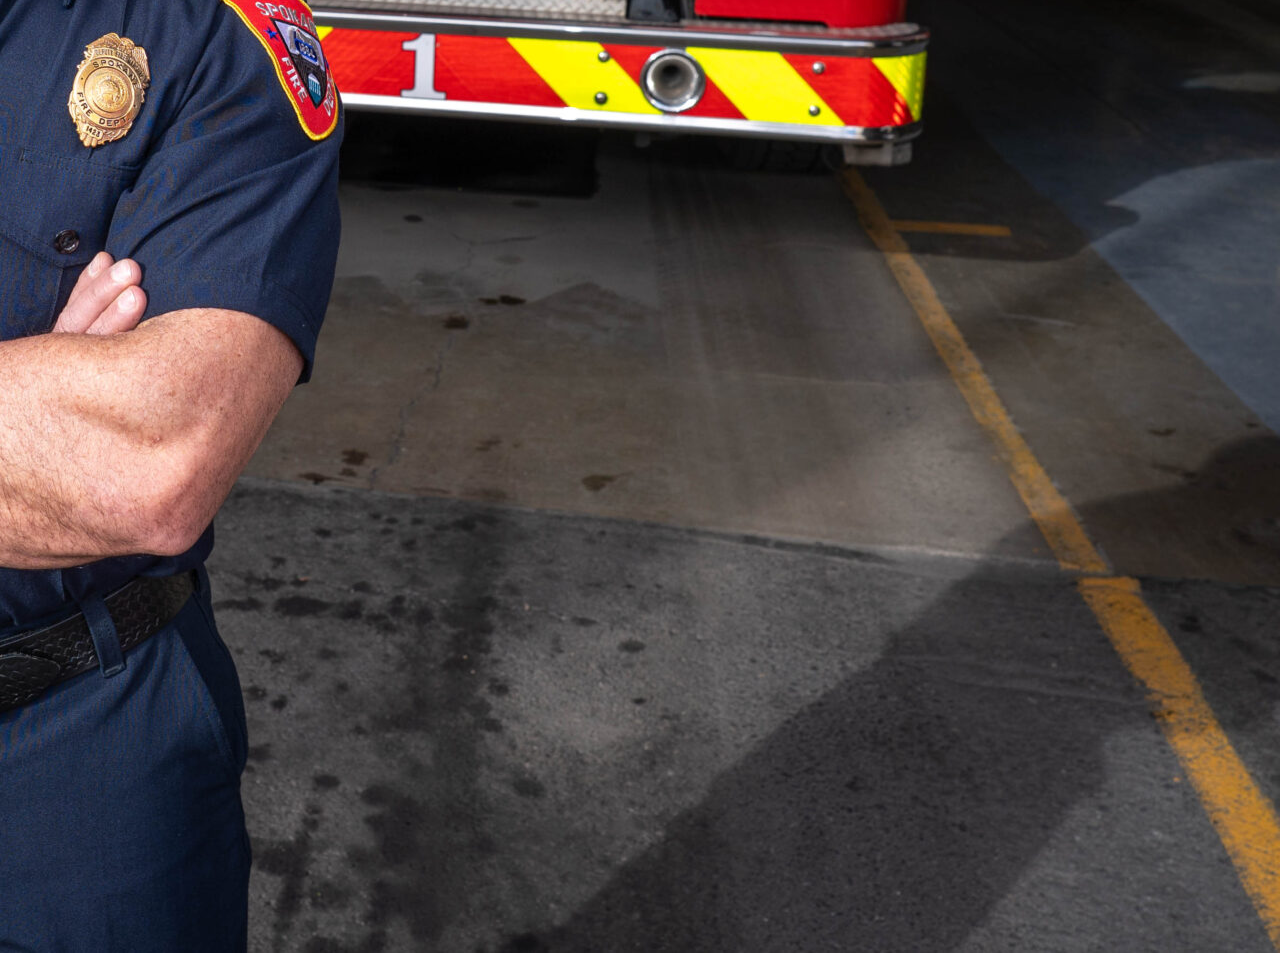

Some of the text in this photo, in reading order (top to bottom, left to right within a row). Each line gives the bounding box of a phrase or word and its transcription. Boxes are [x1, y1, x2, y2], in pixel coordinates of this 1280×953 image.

[282, 56, 308, 103] FIRE
[401, 33, 446, 100] 1
[77, 92, 93, 117] FIRE
[86, 126, 101, 138] 1423
